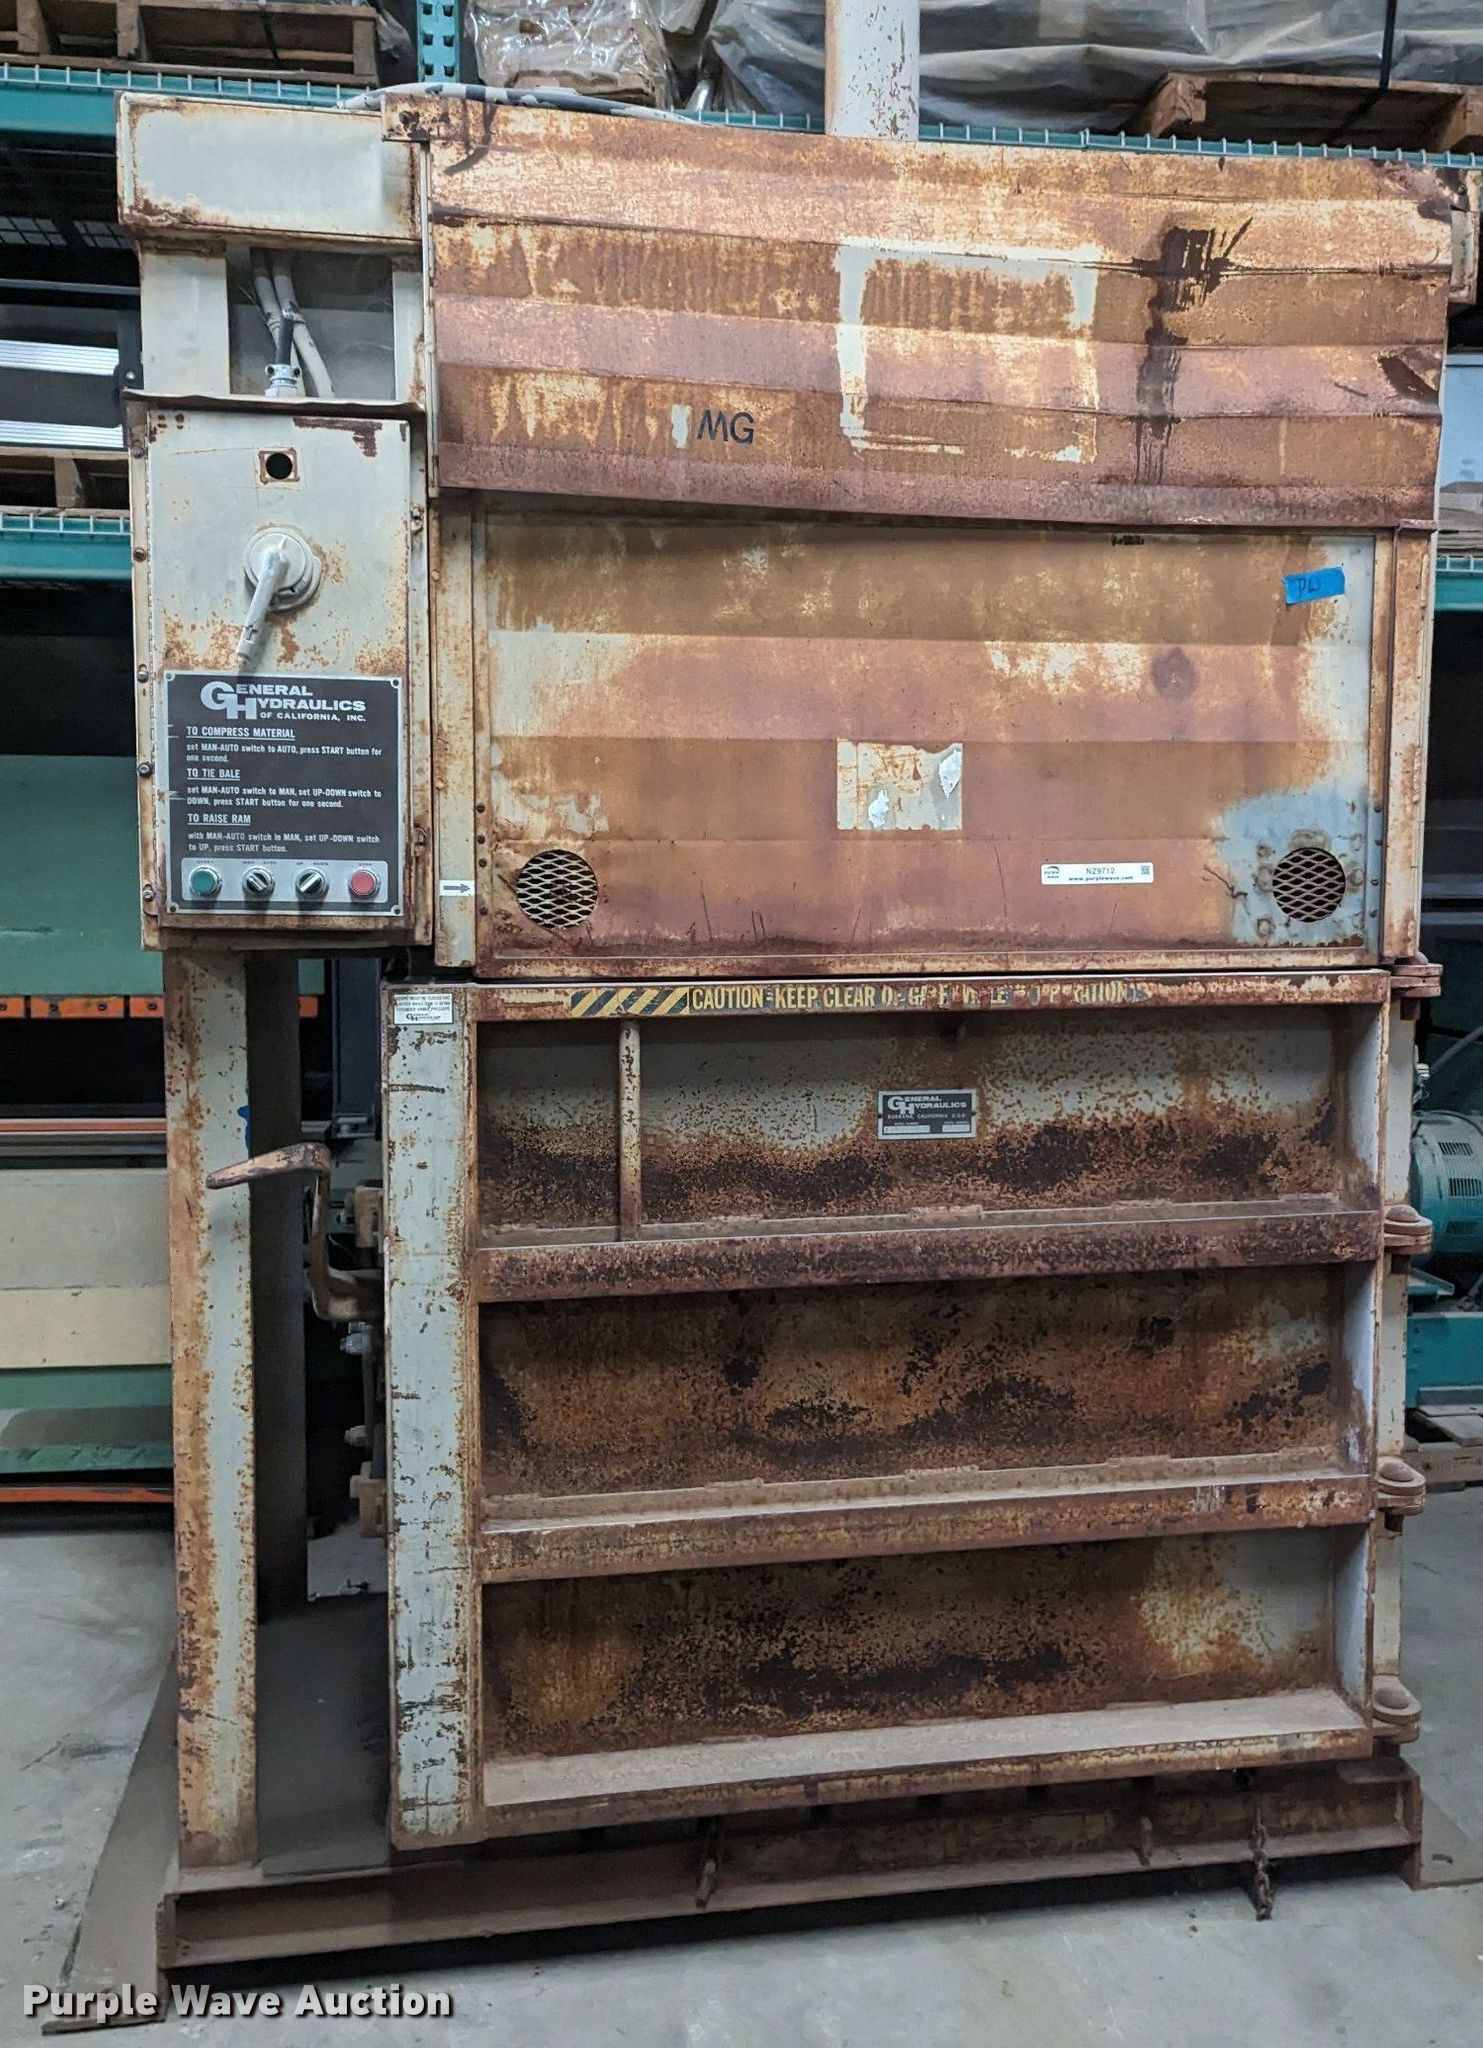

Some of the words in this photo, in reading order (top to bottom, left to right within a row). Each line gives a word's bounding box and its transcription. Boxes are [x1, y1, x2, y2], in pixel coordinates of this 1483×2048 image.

[697, 409, 755, 445] MG
[200, 681, 314, 711] GENERAL
[226, 693, 367, 720] HYDRAULICS
[277, 713, 340, 721] CALIFORNIA,
[186, 726, 198, 736] TO
[201, 727, 250, 737] COMPRESS
[253, 728, 296, 738] MATERIAL
[201, 744, 239, 752] MAN-AUTO
[241, 745, 266, 753] switch
[268, 745, 276, 753] to
[300, 748, 320, 756] press
[321, 747, 344, 755] START
[346, 748, 370, 756] button
[371, 748, 382, 756] for
[187, 768, 199, 778] TO
[202, 768, 216, 778] TIE
[219, 769, 241, 779] BALE
[187, 786, 200, 794] set
[201, 786, 240, 795] MAN-AUTO
[242, 787, 267, 796] switch
[269, 787, 277, 796] to
[278, 787, 297, 797] MAN,
[298, 788, 311, 796] set
[312, 788, 347, 797] UP-DOWN
[347, 789, 371, 798] switch
[374, 790, 382, 798] to
[213, 799, 234, 807] press
[235, 798, 260, 807] START
[261, 799, 287, 807] button
[288, 799, 300, 808] for
[301, 800, 315, 808] one
[317, 800, 344, 808] second.
[187, 813, 200, 823] TO
[202, 814, 229, 823] RAISE
[231, 814, 251, 824] RAM
[188, 832, 204, 840] with
[206, 832, 246, 841] MAN-AUTO
[248, 833, 272, 841] switch
[304, 834, 317, 842] set
[356, 835, 380, 843] switch
[213, 844, 234, 853] press
[236, 844, 259, 852] START
[1086, 867, 1116, 875] NZ9712
[691, 988, 764, 1010] CAUTION
[774, 986, 819, 1009] KEEP
[823, 985, 876, 1007] CLEAR
[887, 1096, 942, 1111] GENERAL
[900, 1101, 967, 1115] HYDRAULICS
